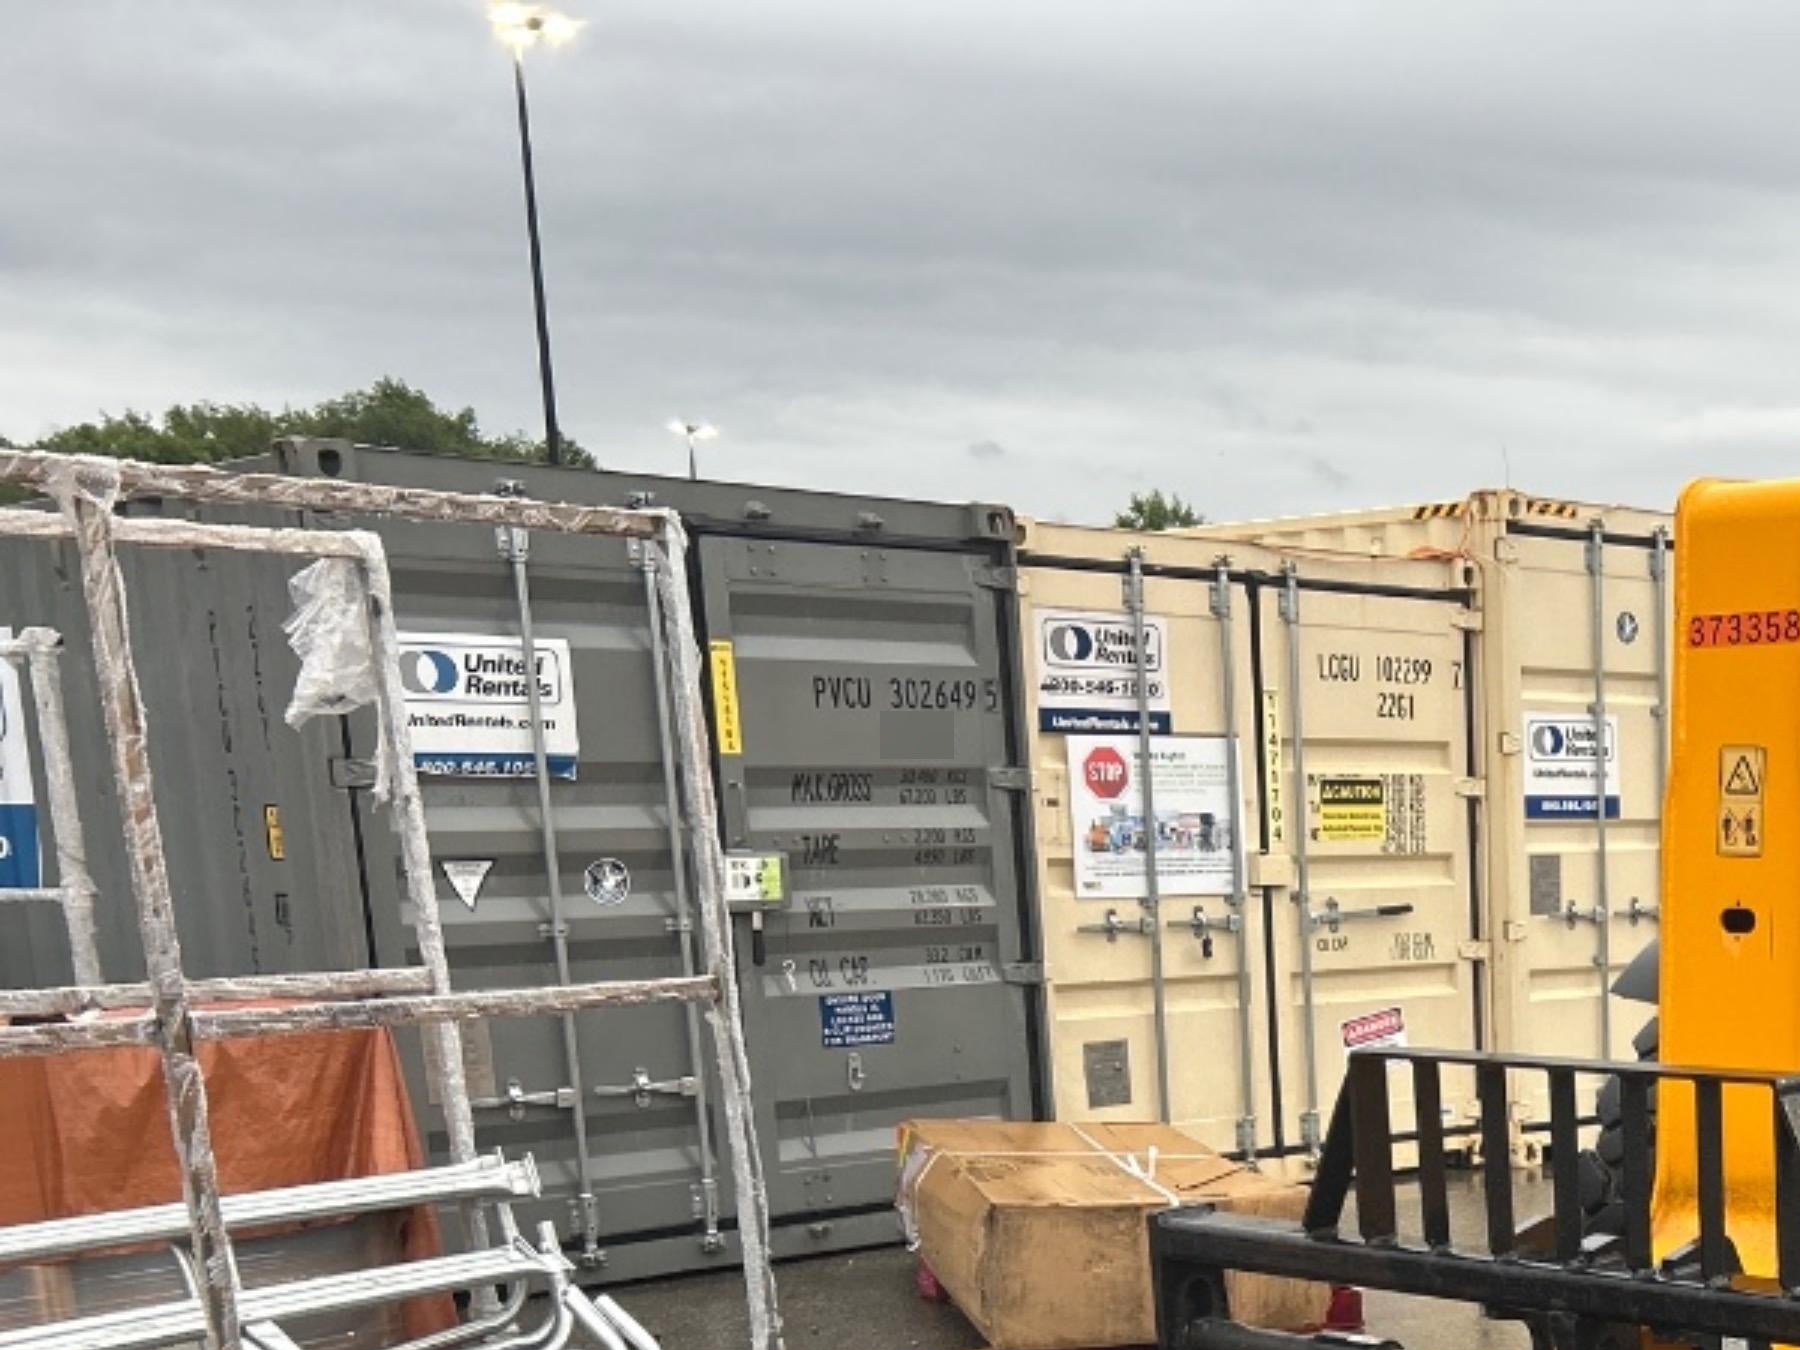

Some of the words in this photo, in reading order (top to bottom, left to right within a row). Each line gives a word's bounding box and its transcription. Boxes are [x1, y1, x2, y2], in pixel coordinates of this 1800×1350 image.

[1690, 610, 1800, 647] 373358
[464, 653, 544, 677] United
[1095, 645, 1155, 665] Rents
[1317, 653, 1360, 682] LCGU
[1376, 655, 1432, 684] 102299
[812, 677, 872, 709] PVCU
[889, 679, 977, 710] 302649
[982, 679, 999, 713] 5
[407, 713, 556, 731] nitedRentals.cm
[1088, 760, 1123, 782] STOP
